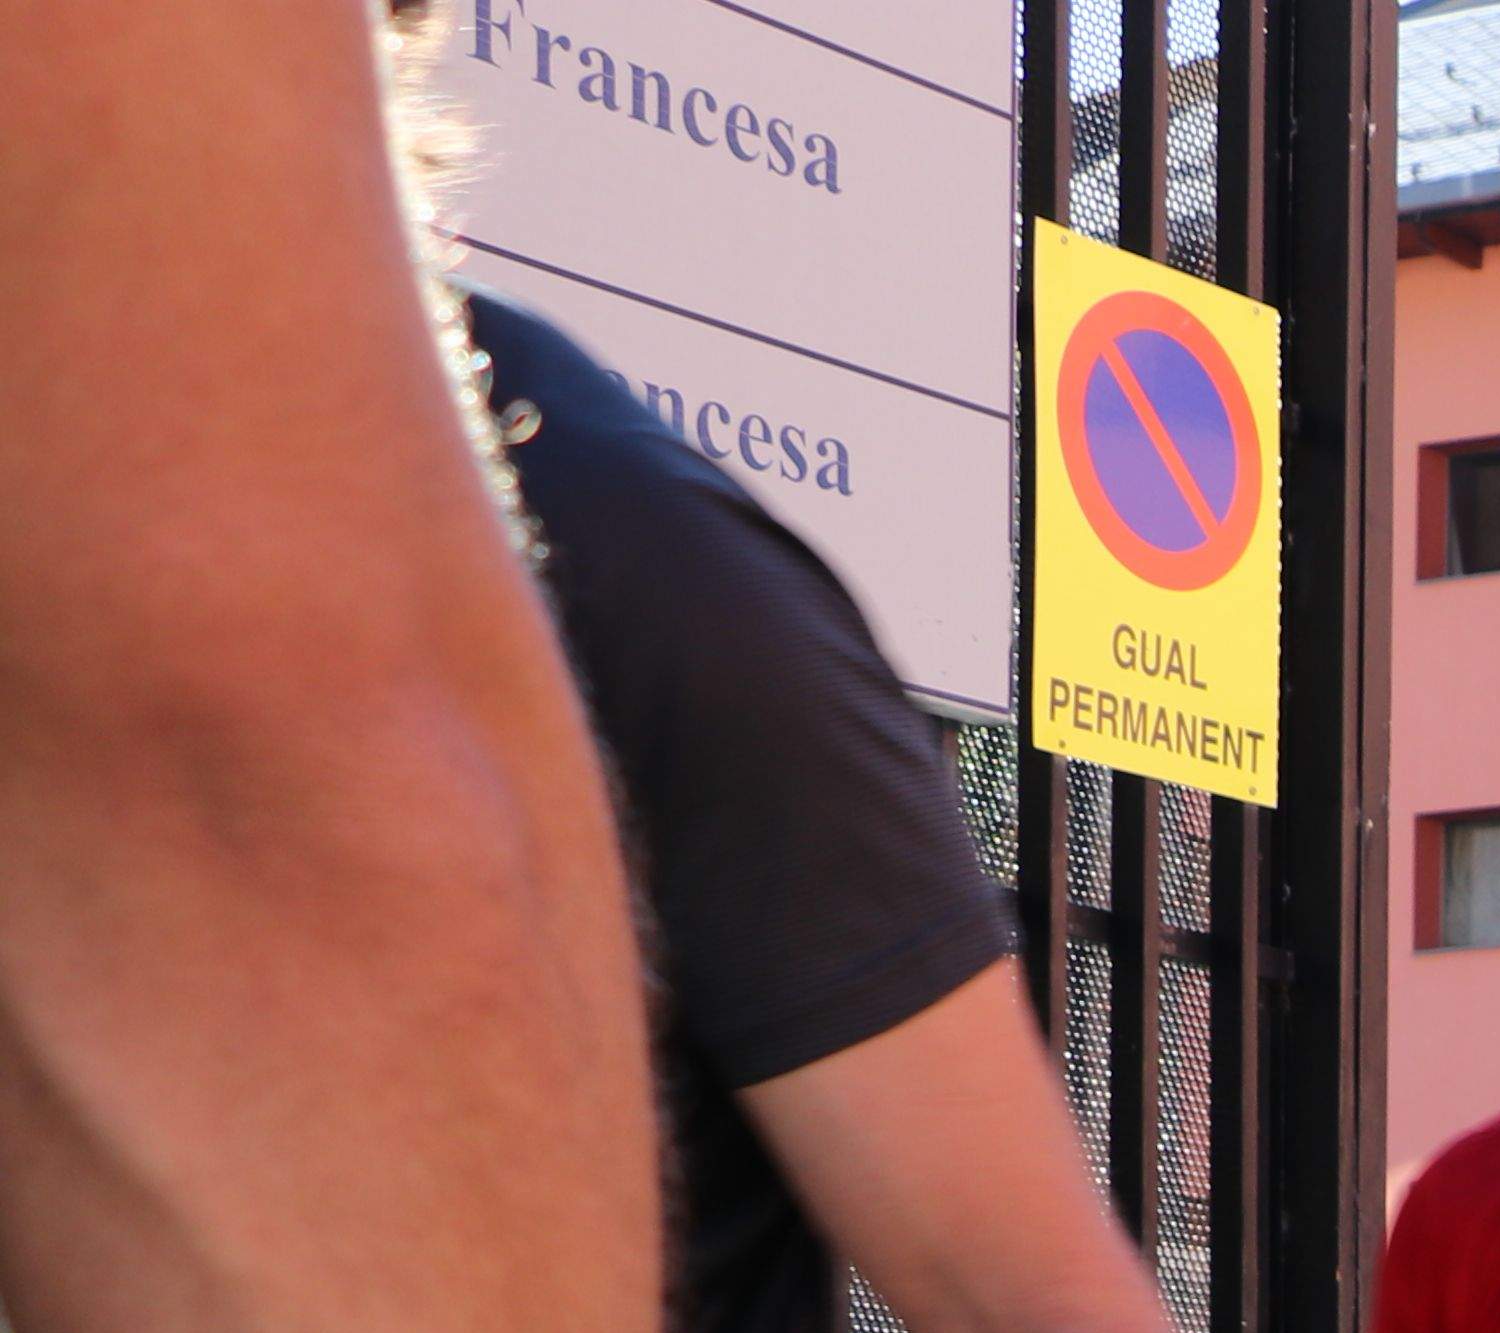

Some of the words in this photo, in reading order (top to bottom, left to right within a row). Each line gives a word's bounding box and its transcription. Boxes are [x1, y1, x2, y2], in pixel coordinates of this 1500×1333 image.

[603, 368, 854, 497] ncesa
[1111, 622, 1208, 692] GUAL
[1048, 677, 1265, 775] PERMANENT
